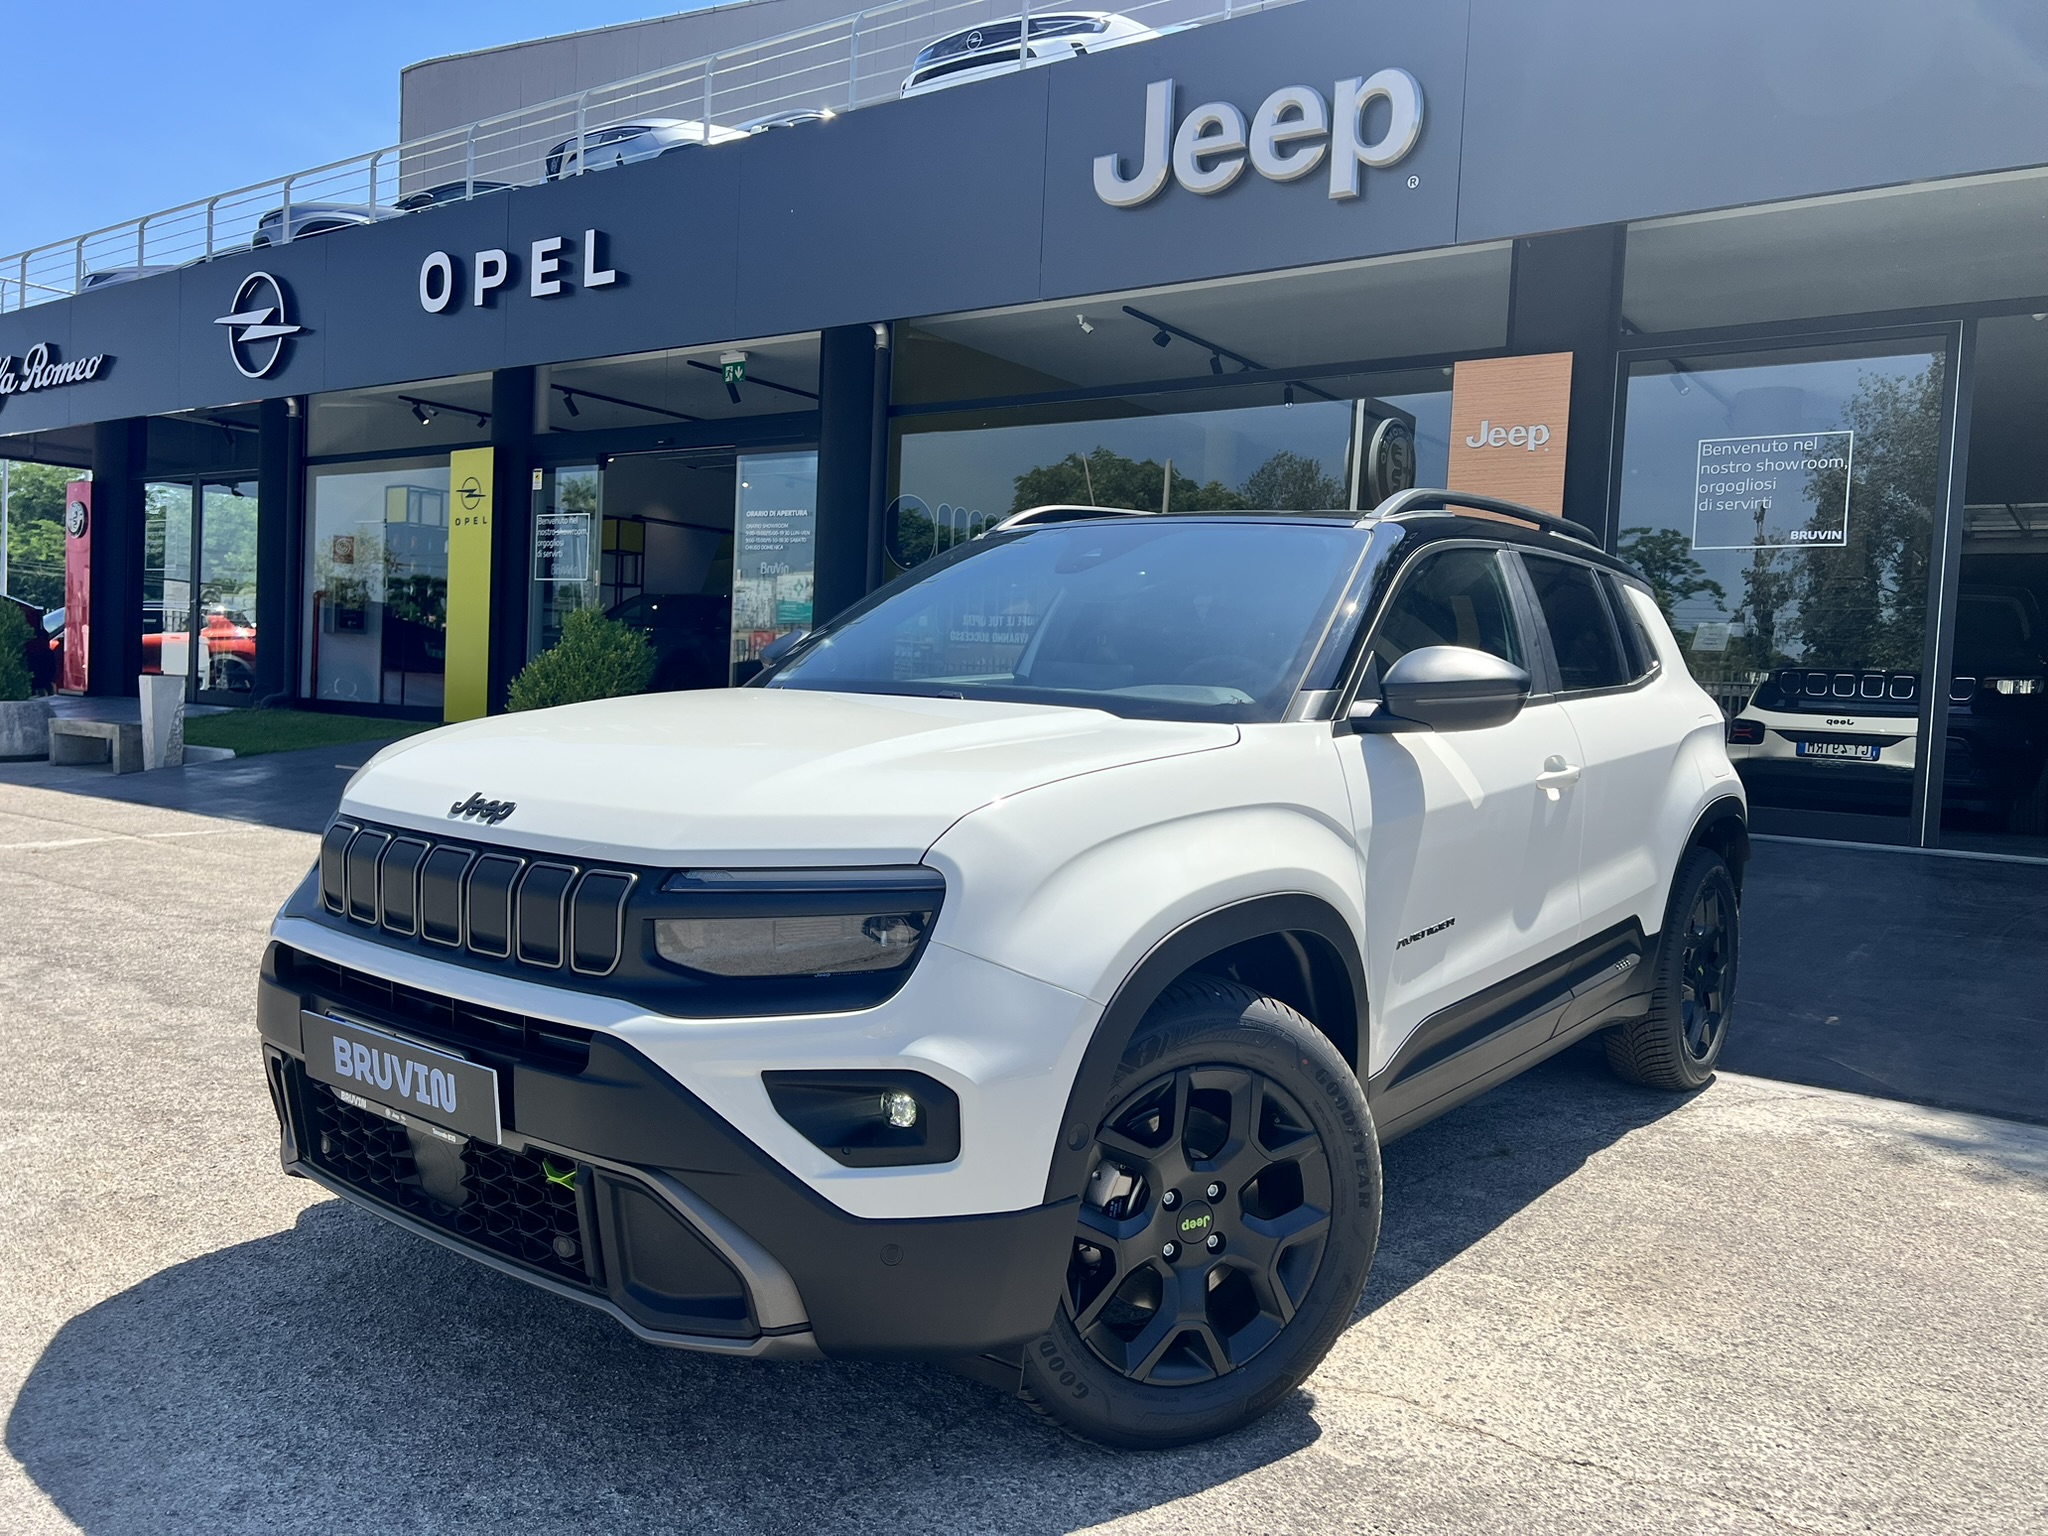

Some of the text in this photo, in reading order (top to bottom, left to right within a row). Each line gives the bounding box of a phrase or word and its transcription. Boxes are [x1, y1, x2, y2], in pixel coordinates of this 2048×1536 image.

[1092, 66, 1425, 208] Jeep
[419, 229, 616, 314] OPEL
[20, 341, 104, 392] Romeo
[1465, 420, 1550, 452] Jeep
[1701, 436, 1818, 457] Benvenuto nel
[1700, 460, 1752, 475] nostro
[1698, 477, 1777, 496] orgogliosi
[777, 509, 808, 517] APERTURA
[1698, 496, 1773, 511] di servirti
[455, 515, 488, 527] OPEL
[1790, 530, 1843, 540] BRUVIN
[450, 791, 518, 825] Jeep
[332, 1035, 457, 1114] BRUVIN
[340, 1090, 368, 1109] BRUVIN
[1315, 1067, 1371, 1210] GOODYEAR
[1181, 1214, 1211, 1231] Jeep
